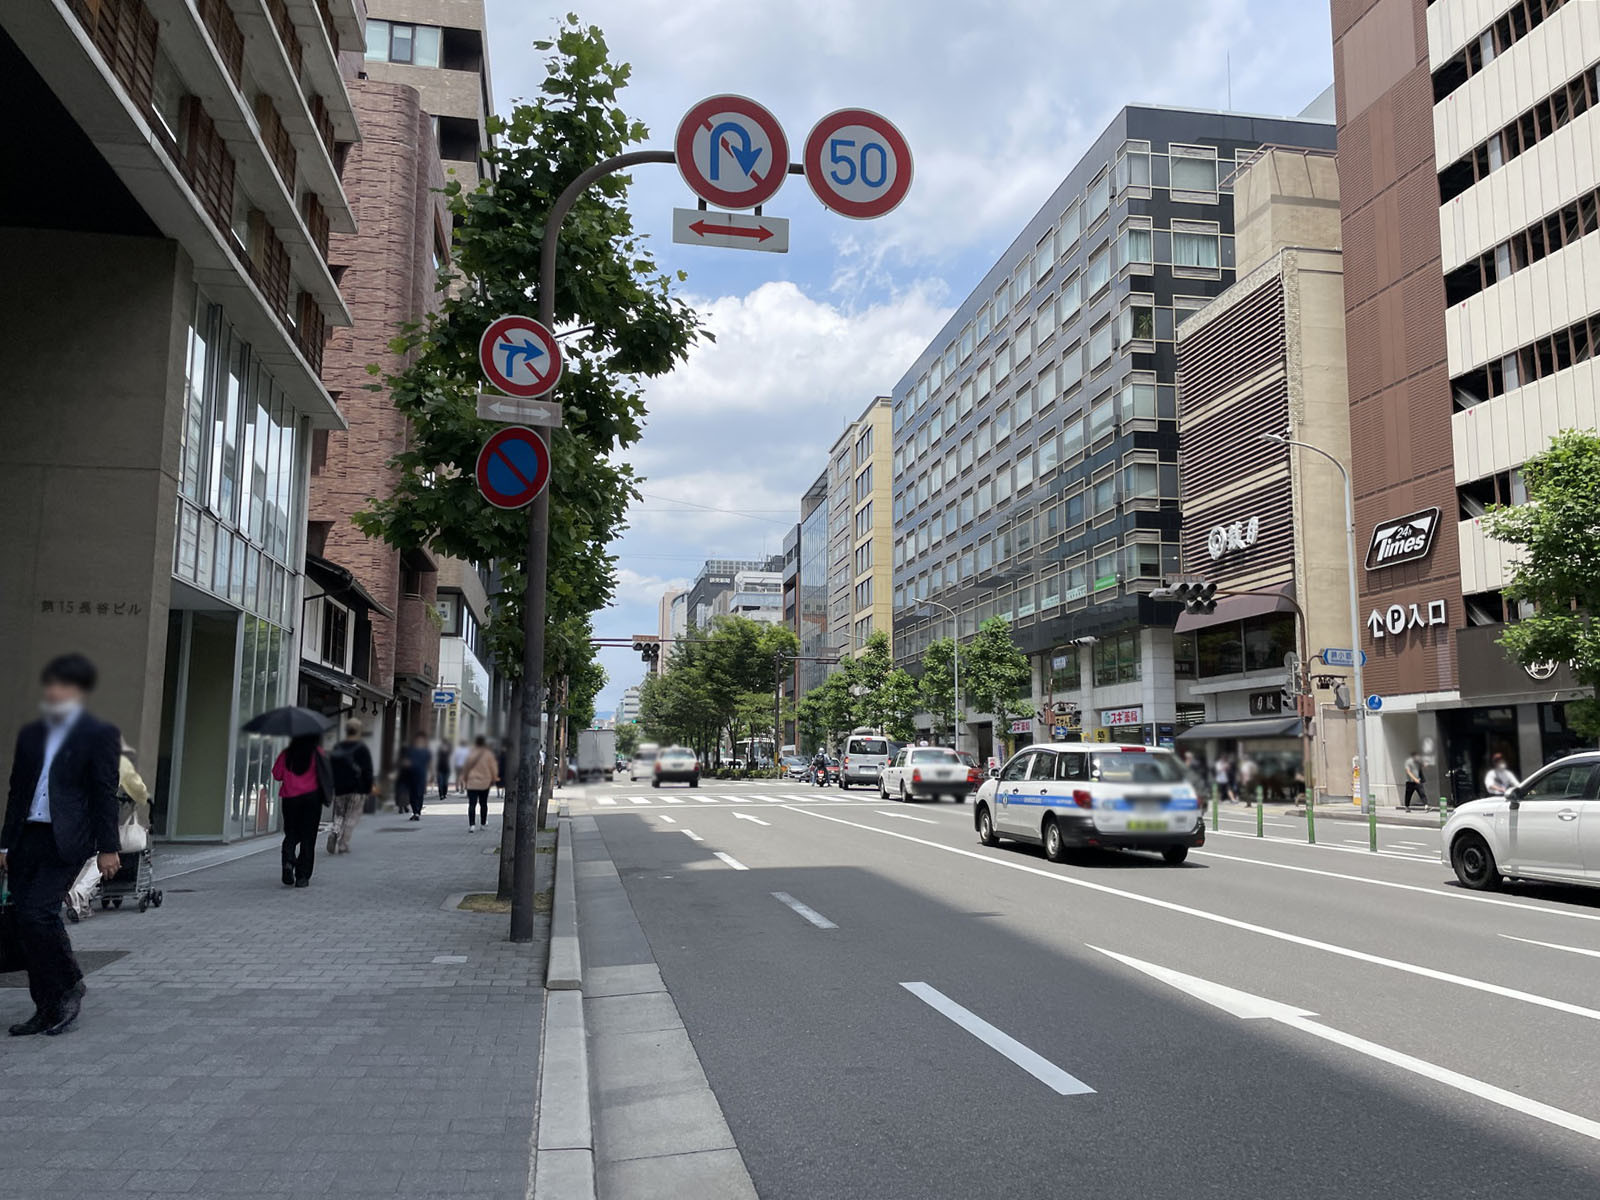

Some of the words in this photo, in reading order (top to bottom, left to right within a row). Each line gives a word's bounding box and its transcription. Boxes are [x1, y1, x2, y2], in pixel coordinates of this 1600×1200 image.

[830, 138, 887, 188] 50
[1376, 534, 1426, 562] Times
[40, 599, 142, 616] 第15長谷ビル
[1110, 710, 1138, 724] スギ薬局
